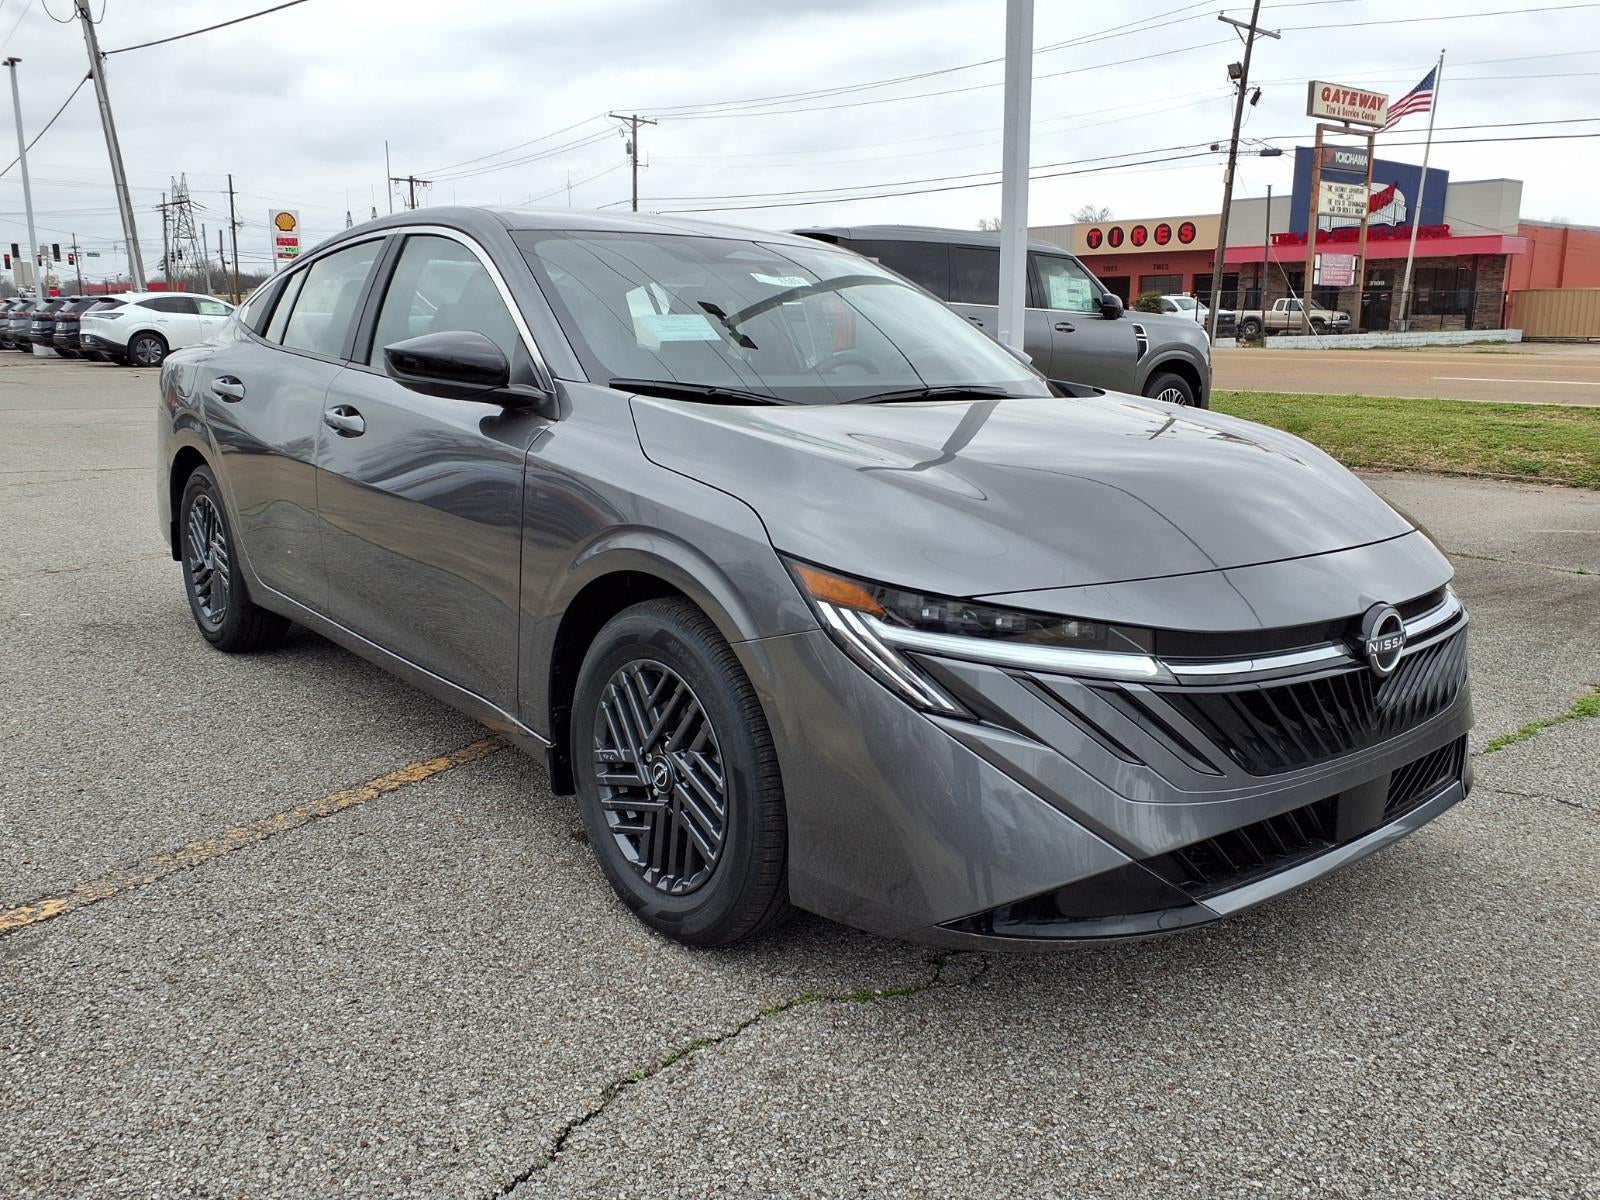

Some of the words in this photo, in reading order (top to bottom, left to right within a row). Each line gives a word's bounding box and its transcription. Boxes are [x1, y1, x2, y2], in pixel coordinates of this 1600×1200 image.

[1322, 87, 1385, 111] GATEWAY
[1326, 104, 1336, 114] Tire
[1342, 107, 1360, 119] Service
[1362, 111, 1377, 121] Center
[1335, 151, 1368, 166] YOKOHAMA
[1090, 224, 1194, 248] TIRES
